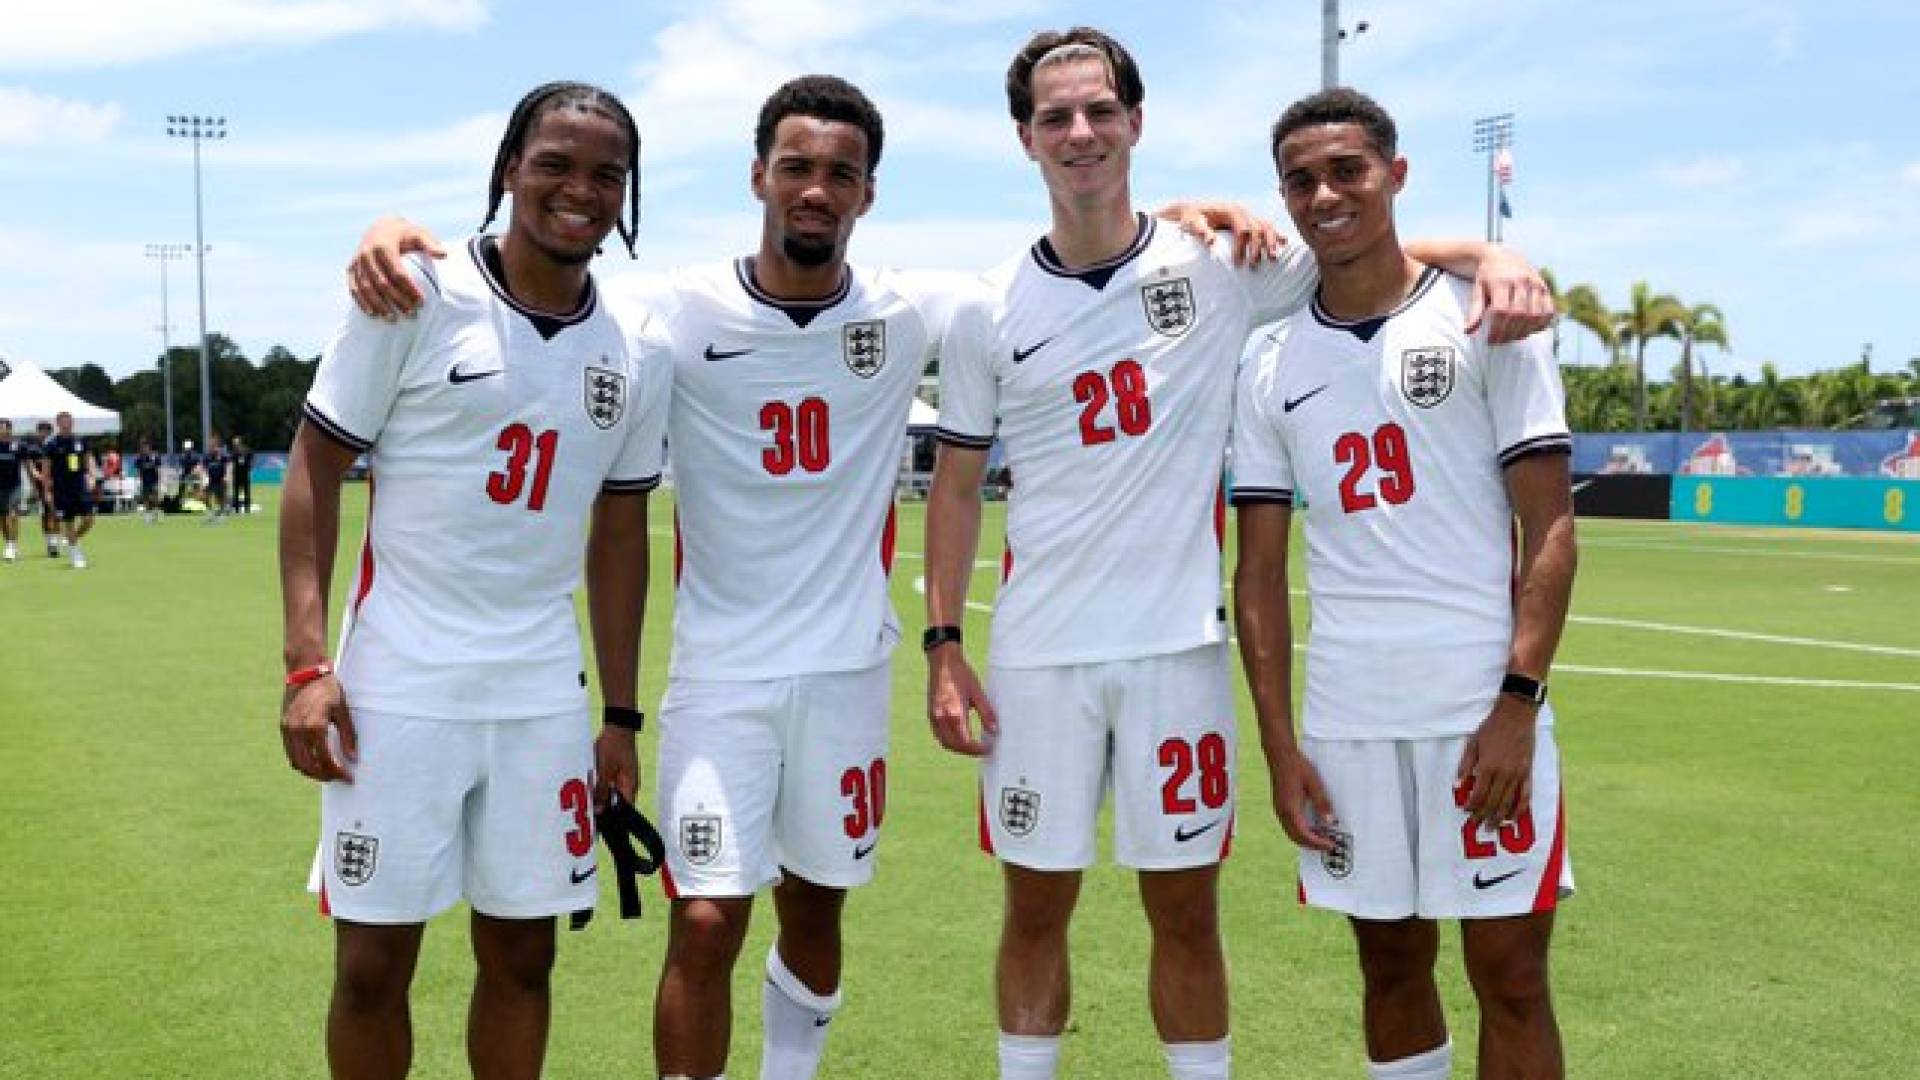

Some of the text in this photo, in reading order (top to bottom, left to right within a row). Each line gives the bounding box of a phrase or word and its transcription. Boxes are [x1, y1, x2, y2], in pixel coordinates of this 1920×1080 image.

[760, 398, 830, 476] 30
[1074, 359, 1151, 445] 28
[486, 423, 559, 511] 31
[1334, 423, 1415, 514] 29
[560, 770, 594, 858] 3
[1157, 732, 1228, 816] 28
